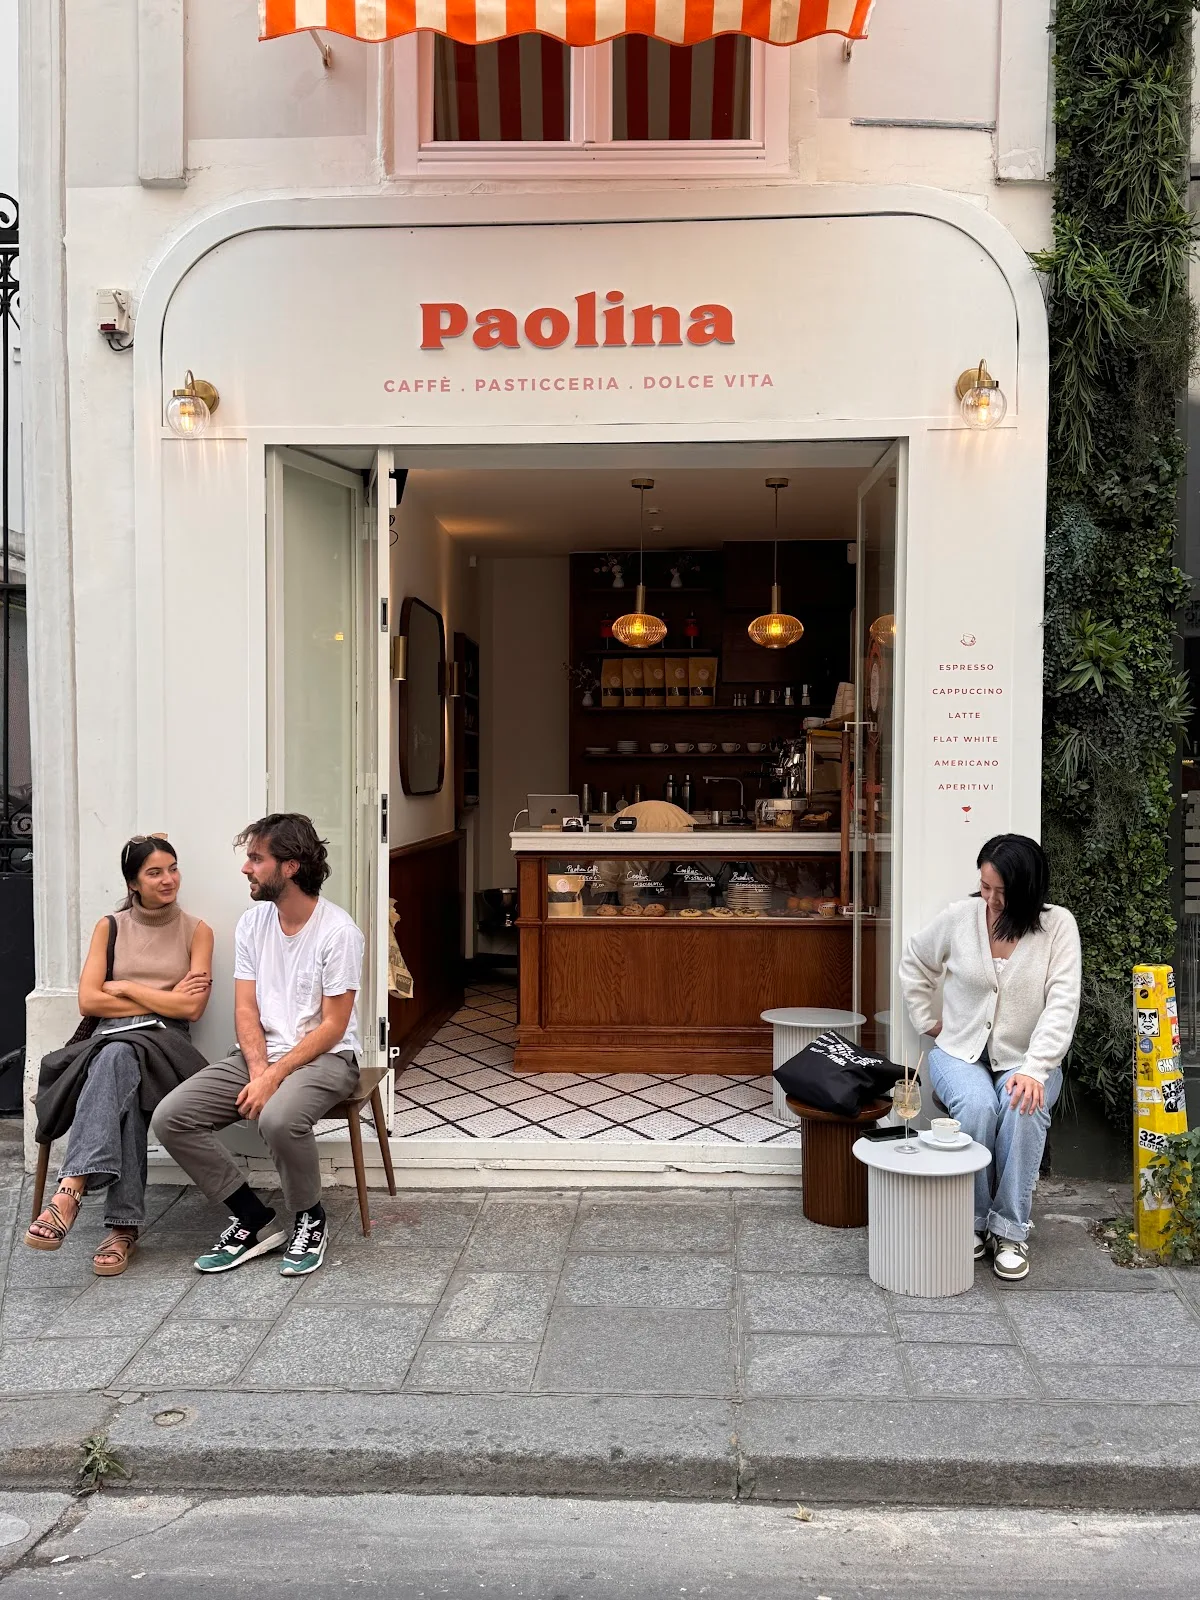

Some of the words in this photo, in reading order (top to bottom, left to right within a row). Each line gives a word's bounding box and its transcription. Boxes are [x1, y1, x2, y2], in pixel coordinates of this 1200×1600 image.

[420, 290, 735, 350] Paolina
[383, 376, 452, 393] CAFFÈ
[475, 376, 619, 392] PASTICCERIA
[643, 375, 714, 390] DOLCE
[724, 373, 774, 388] VITA
[938, 663, 995, 671] ESPRESSO
[931, 687, 1003, 696] CAPPUCCINO
[948, 711, 981, 719] LATTE
[933, 735, 959, 743] FLAT
[963, 735, 999, 743] WHITE
[933, 759, 1000, 767] AMERICANO
[937, 783, 995, 791] APERITIVI
[1139, 1130, 1165, 1146] 322
